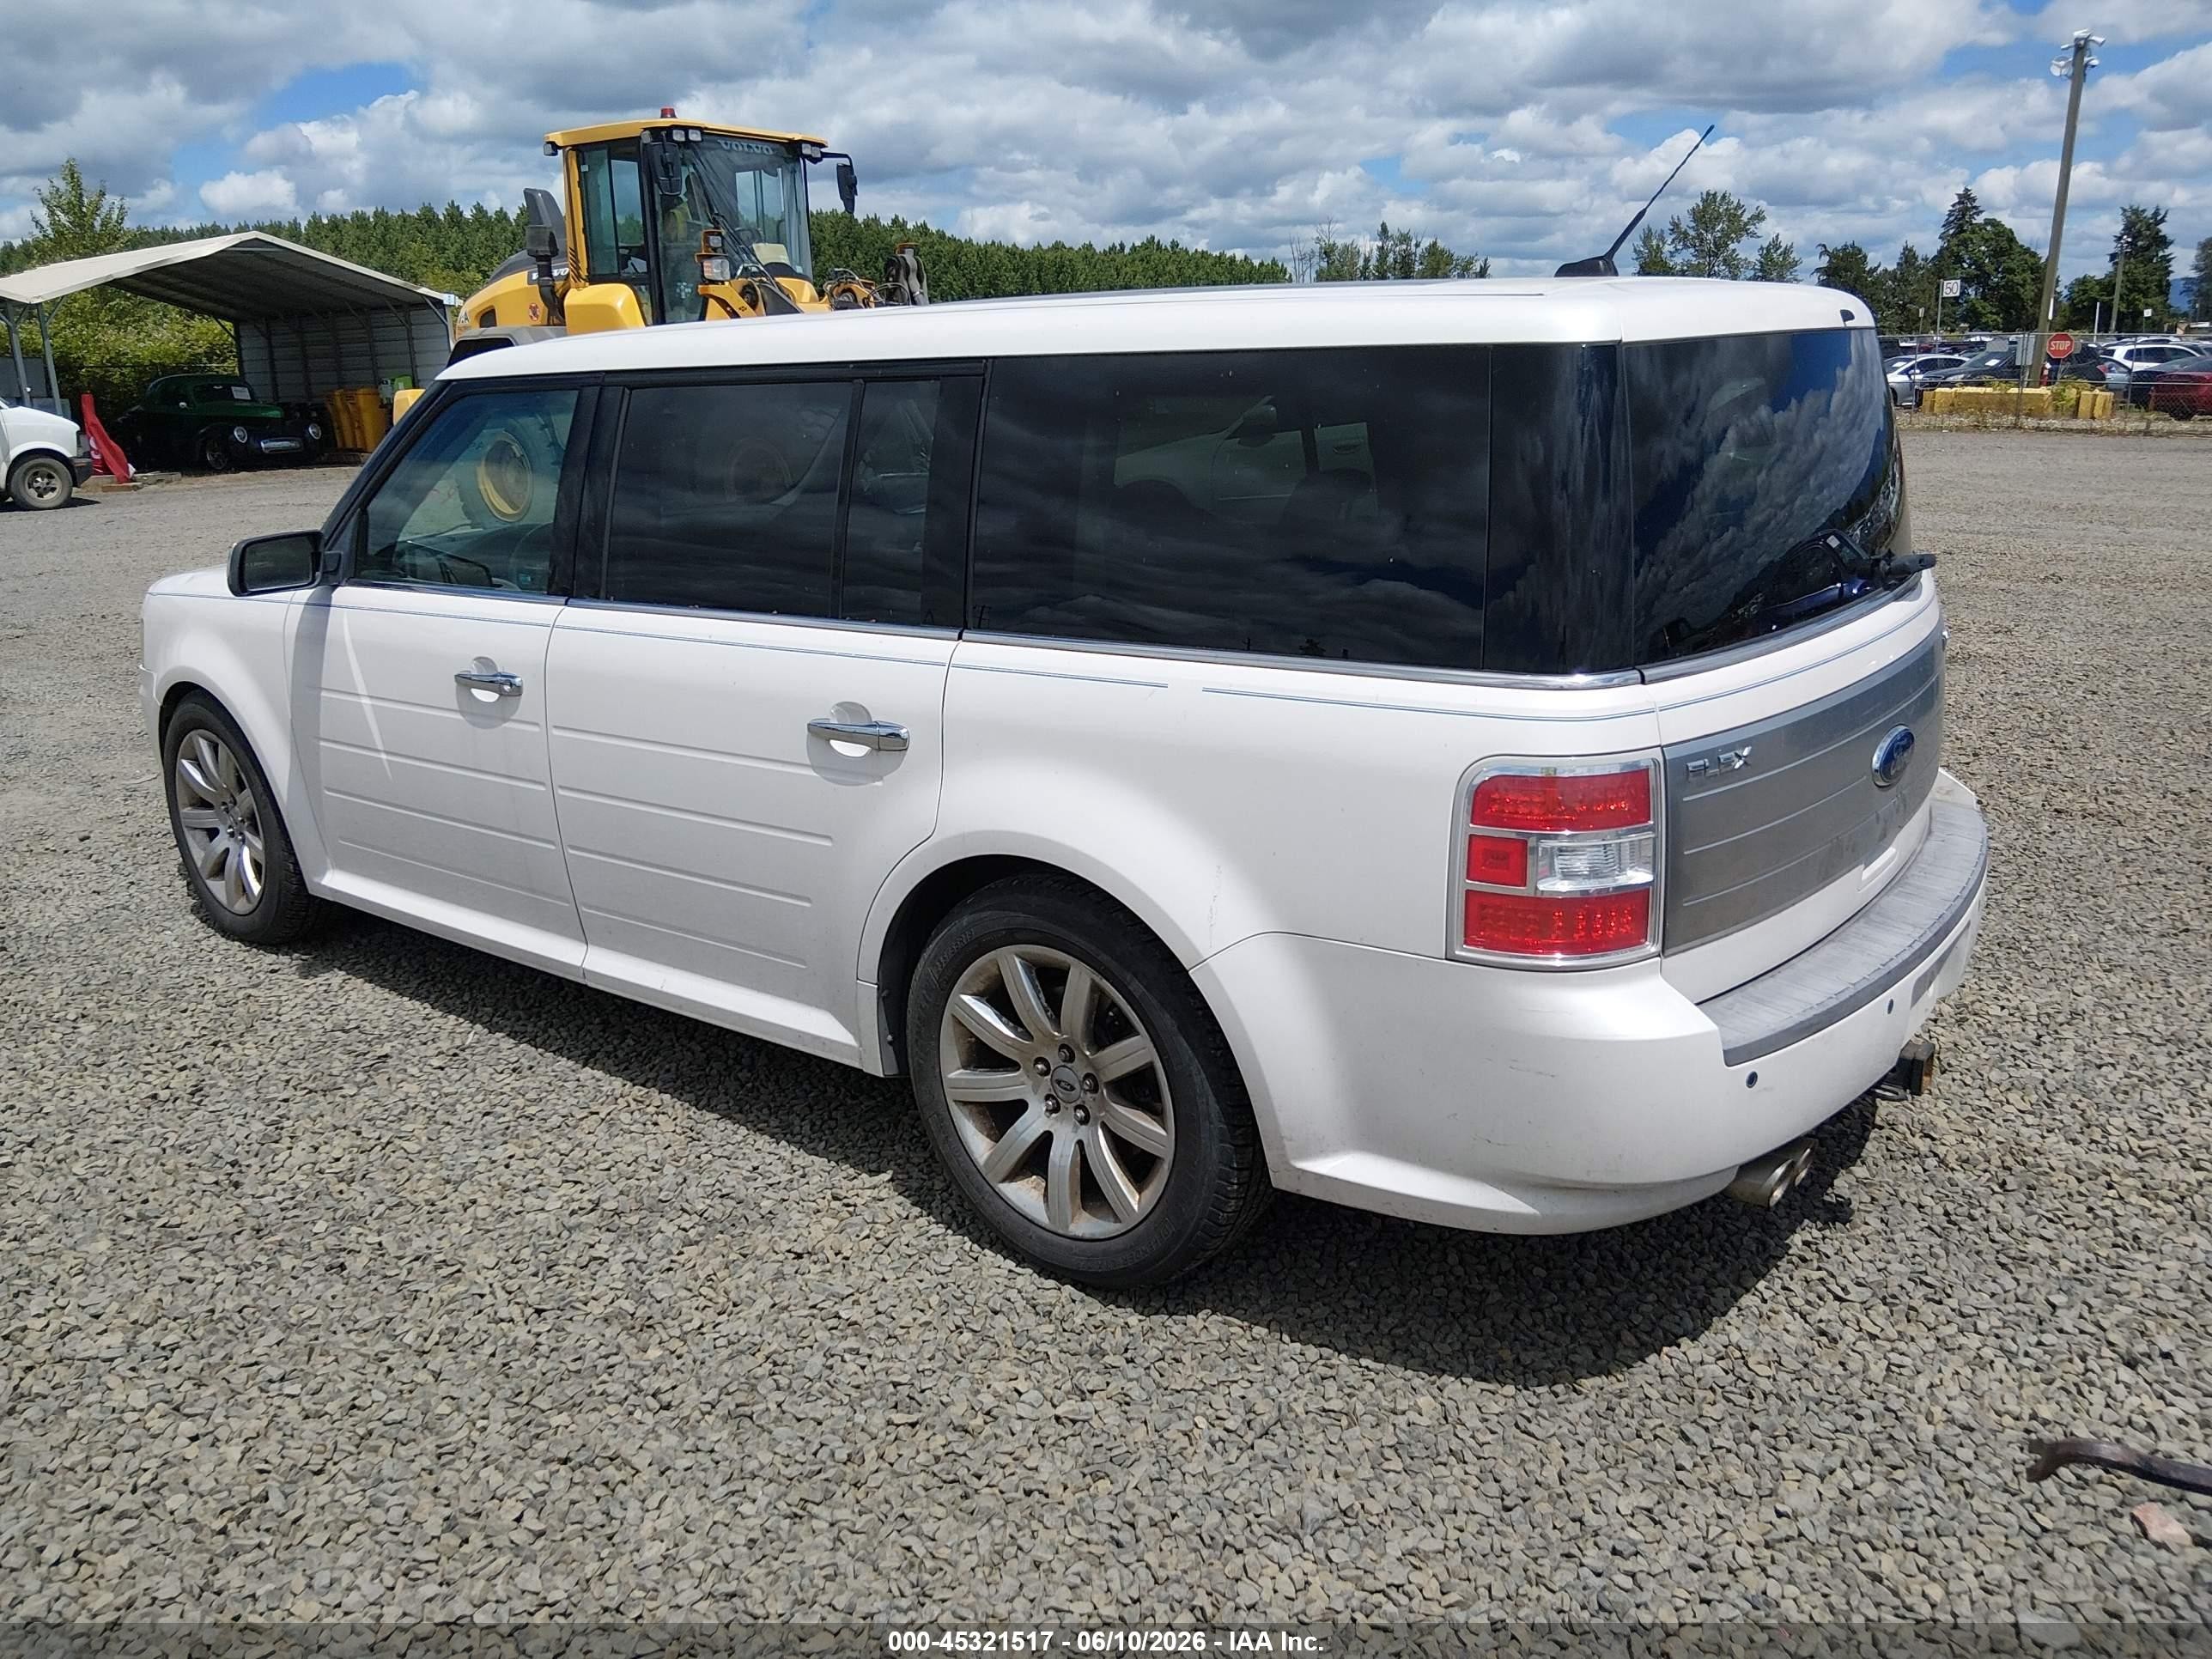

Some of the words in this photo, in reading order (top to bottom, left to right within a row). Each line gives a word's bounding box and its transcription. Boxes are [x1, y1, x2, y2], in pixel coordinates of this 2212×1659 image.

[716, 138, 774, 155] VOLVO
[532, 267, 570, 281] VVO
[1944, 281, 1959, 295] 50
[2049, 340, 2071, 350] STOP
[1686, 745, 1753, 784] FLEX
